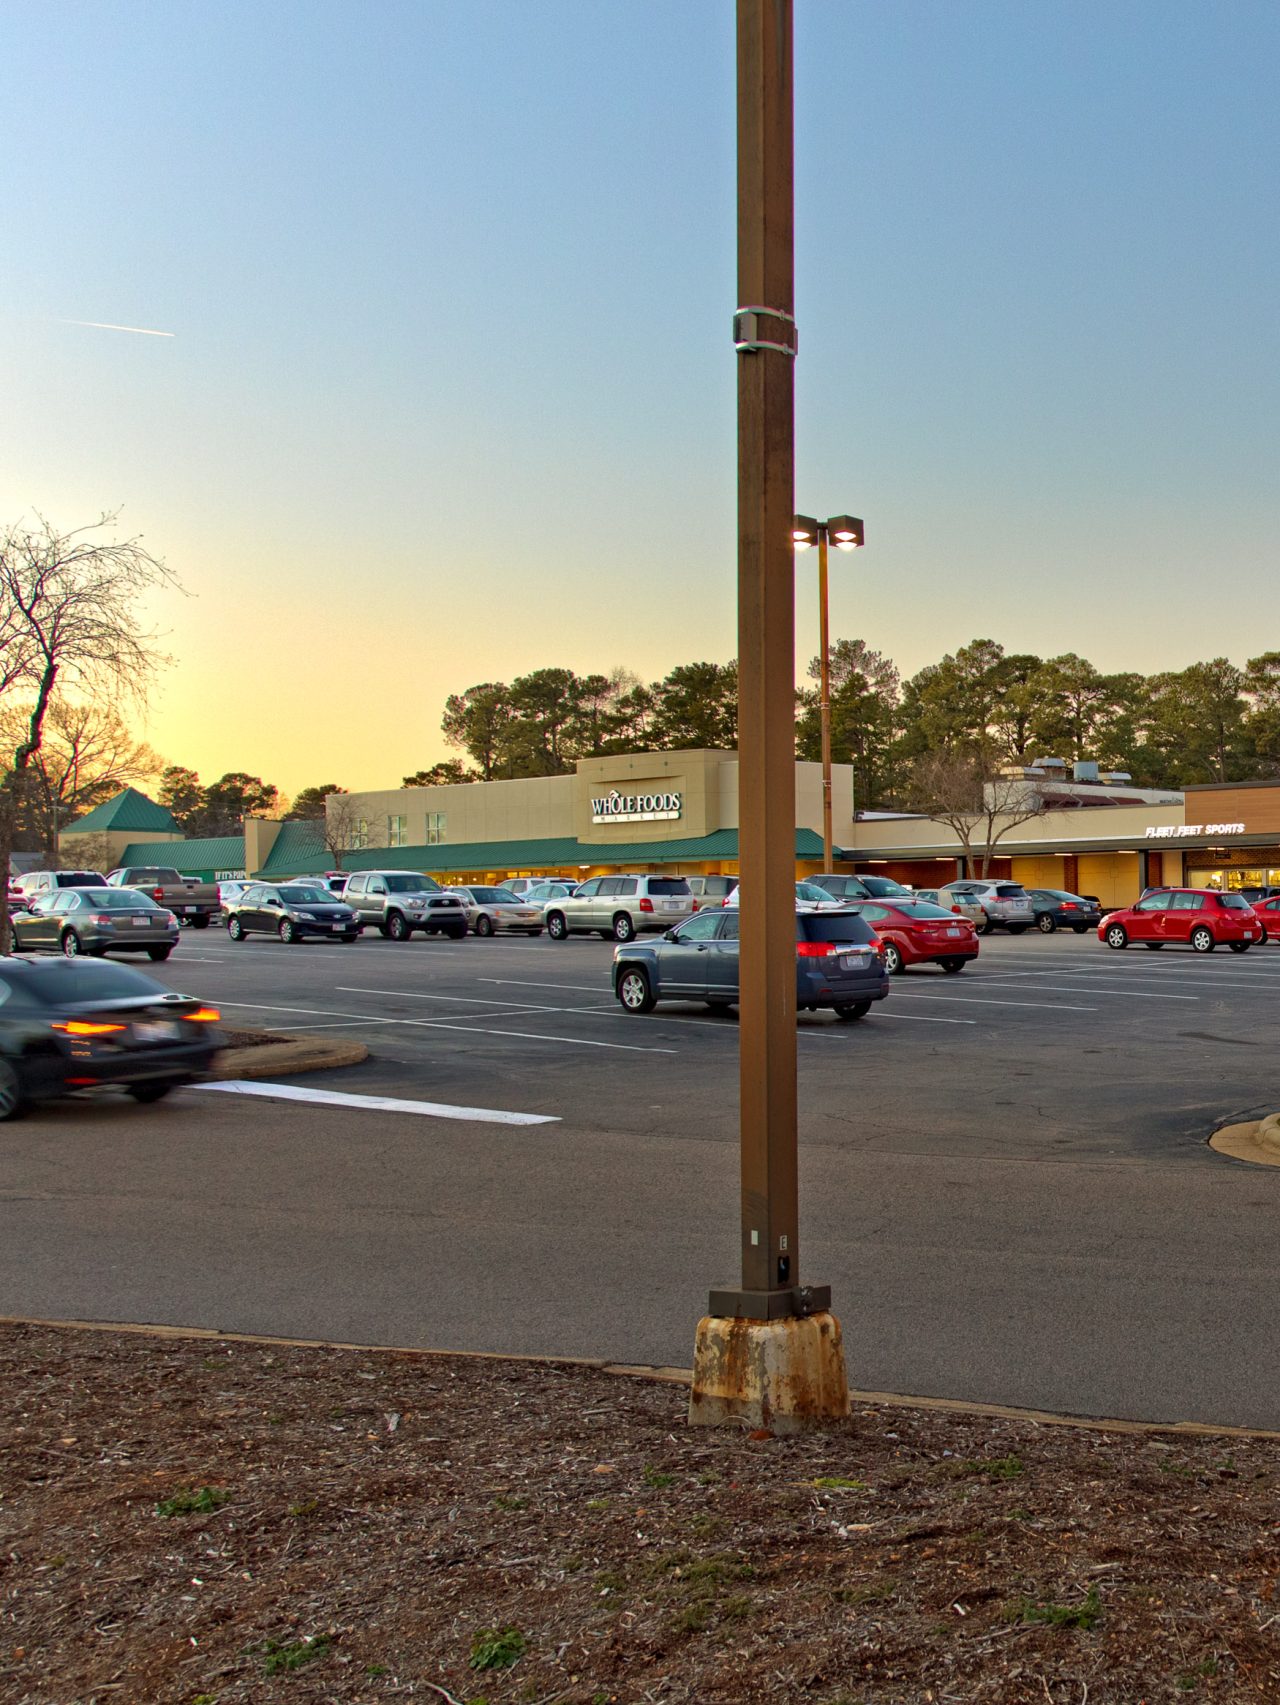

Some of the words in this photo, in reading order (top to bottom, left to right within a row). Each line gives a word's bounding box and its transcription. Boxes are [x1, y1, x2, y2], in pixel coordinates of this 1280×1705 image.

[591, 796, 634, 815] WHOLE
[636, 793, 680, 812] FOODS
[1145, 826, 1175, 837] FLEET
[1178, 825, 1203, 836] FEET
[1205, 823, 1245, 834] SPORTS
